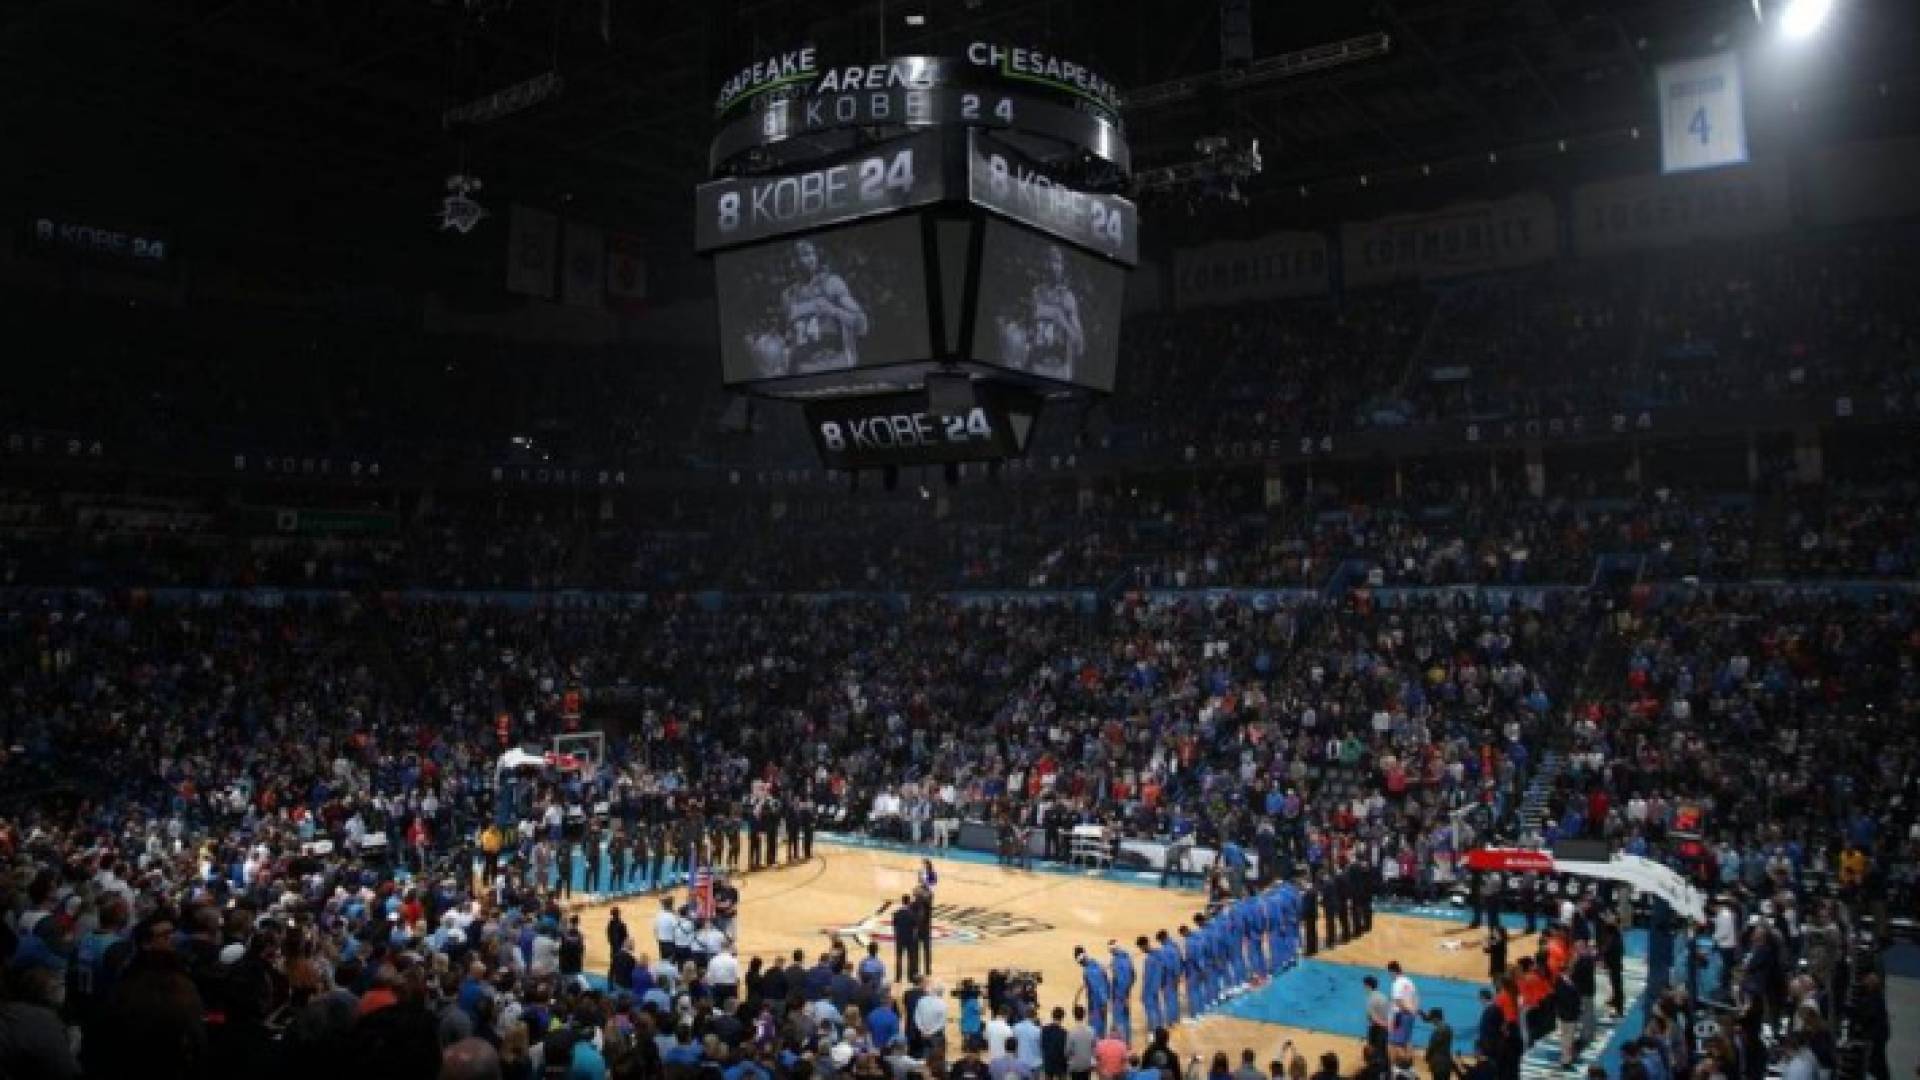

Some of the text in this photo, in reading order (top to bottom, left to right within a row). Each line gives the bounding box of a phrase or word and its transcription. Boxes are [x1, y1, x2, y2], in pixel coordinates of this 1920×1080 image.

[967, 42, 1121, 105] CHESAPEAKE
[807, 92, 928, 126] KOBE
[961, 92, 1014, 122] 24
[1687, 104, 1711, 146] 4
[718, 147, 914, 231] 8 KOBE 24
[990, 153, 1007, 193] 8
[1091, 199, 1121, 247] 24
[133, 236, 168, 258] 24
[795, 317, 819, 345] 24
[821, 407, 991, 453] 8 KOBE 24
[1611, 408, 1654, 432] 24
[1301, 435, 1333, 454] 24
[351, 457, 380, 475] 24
[598, 469, 625, 485] 24
